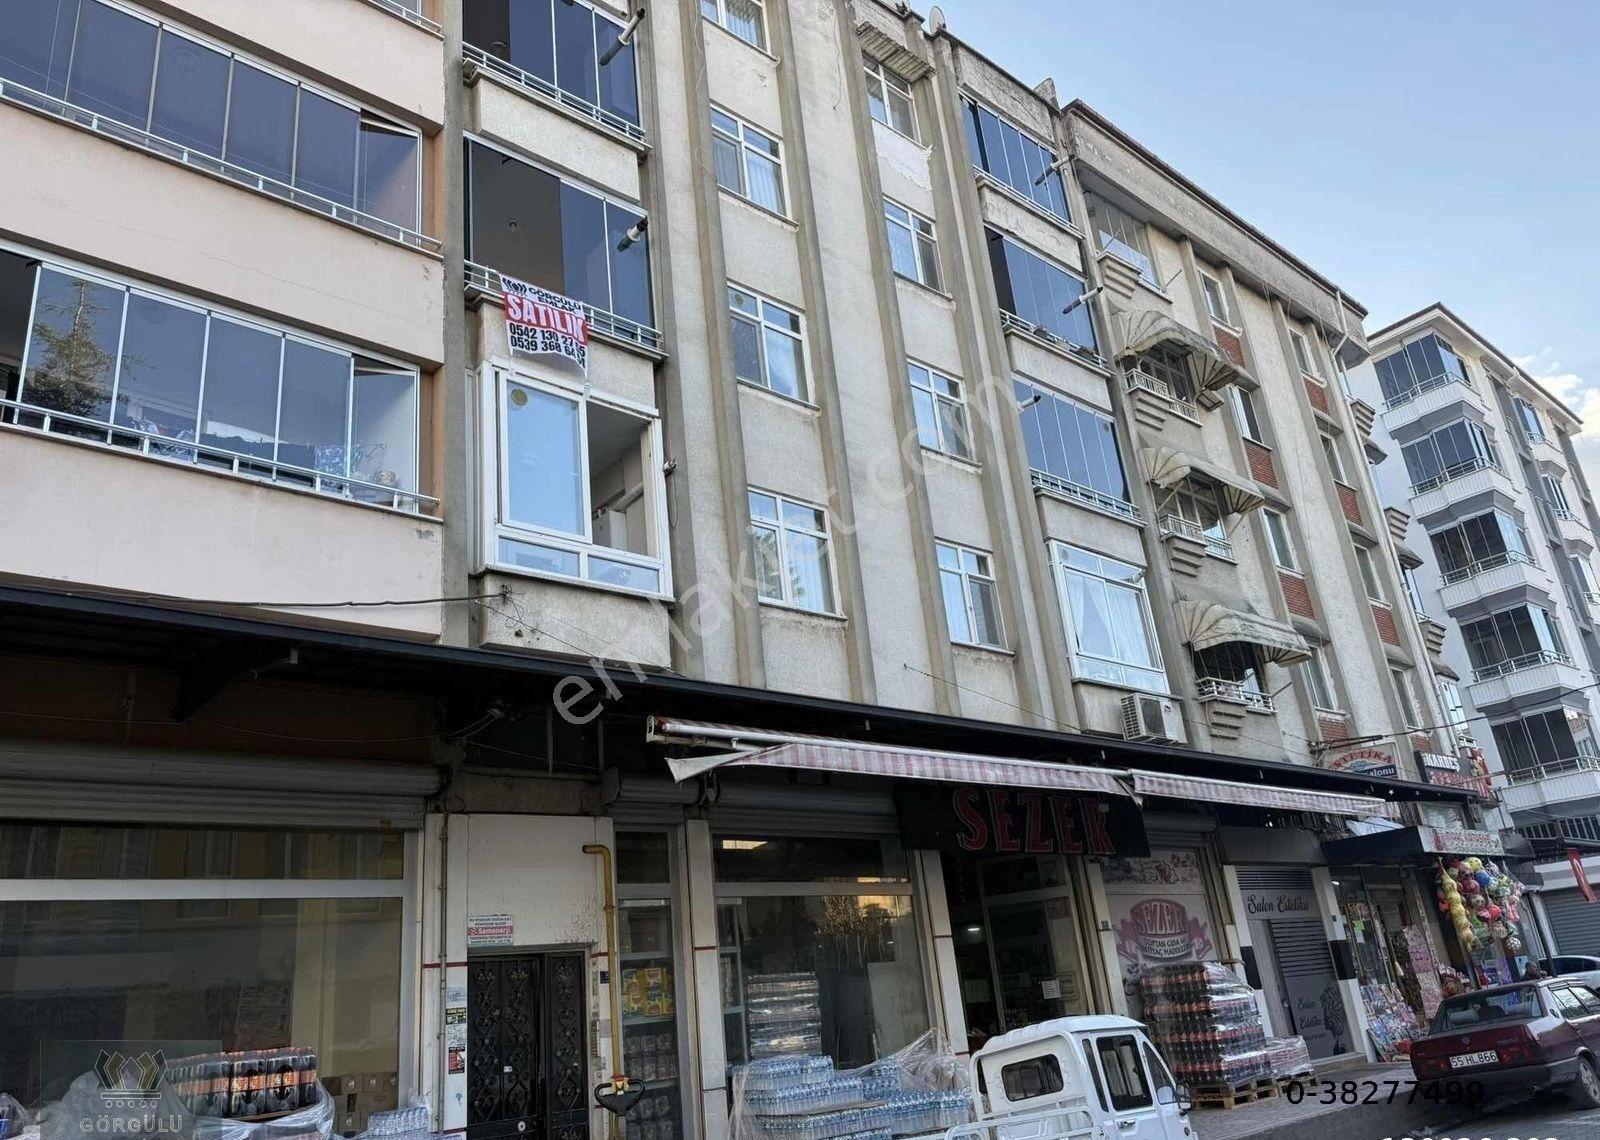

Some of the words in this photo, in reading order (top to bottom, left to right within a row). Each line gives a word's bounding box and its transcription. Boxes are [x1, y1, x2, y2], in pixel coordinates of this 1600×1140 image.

[507, 293, 585, 343] SATILIK
[509, 323, 538, 340] 0542
[540, 330, 559, 342] 130
[561, 335, 574, 347] 27
[510, 336, 538, 351] 0539
[541, 341, 562, 353] 368
[1368, 767, 1396, 777] alonu
[953, 787, 1117, 855] SEZER
[1247, 894, 1274, 914] Salon
[1478, 1052, 1497, 1063] 866
